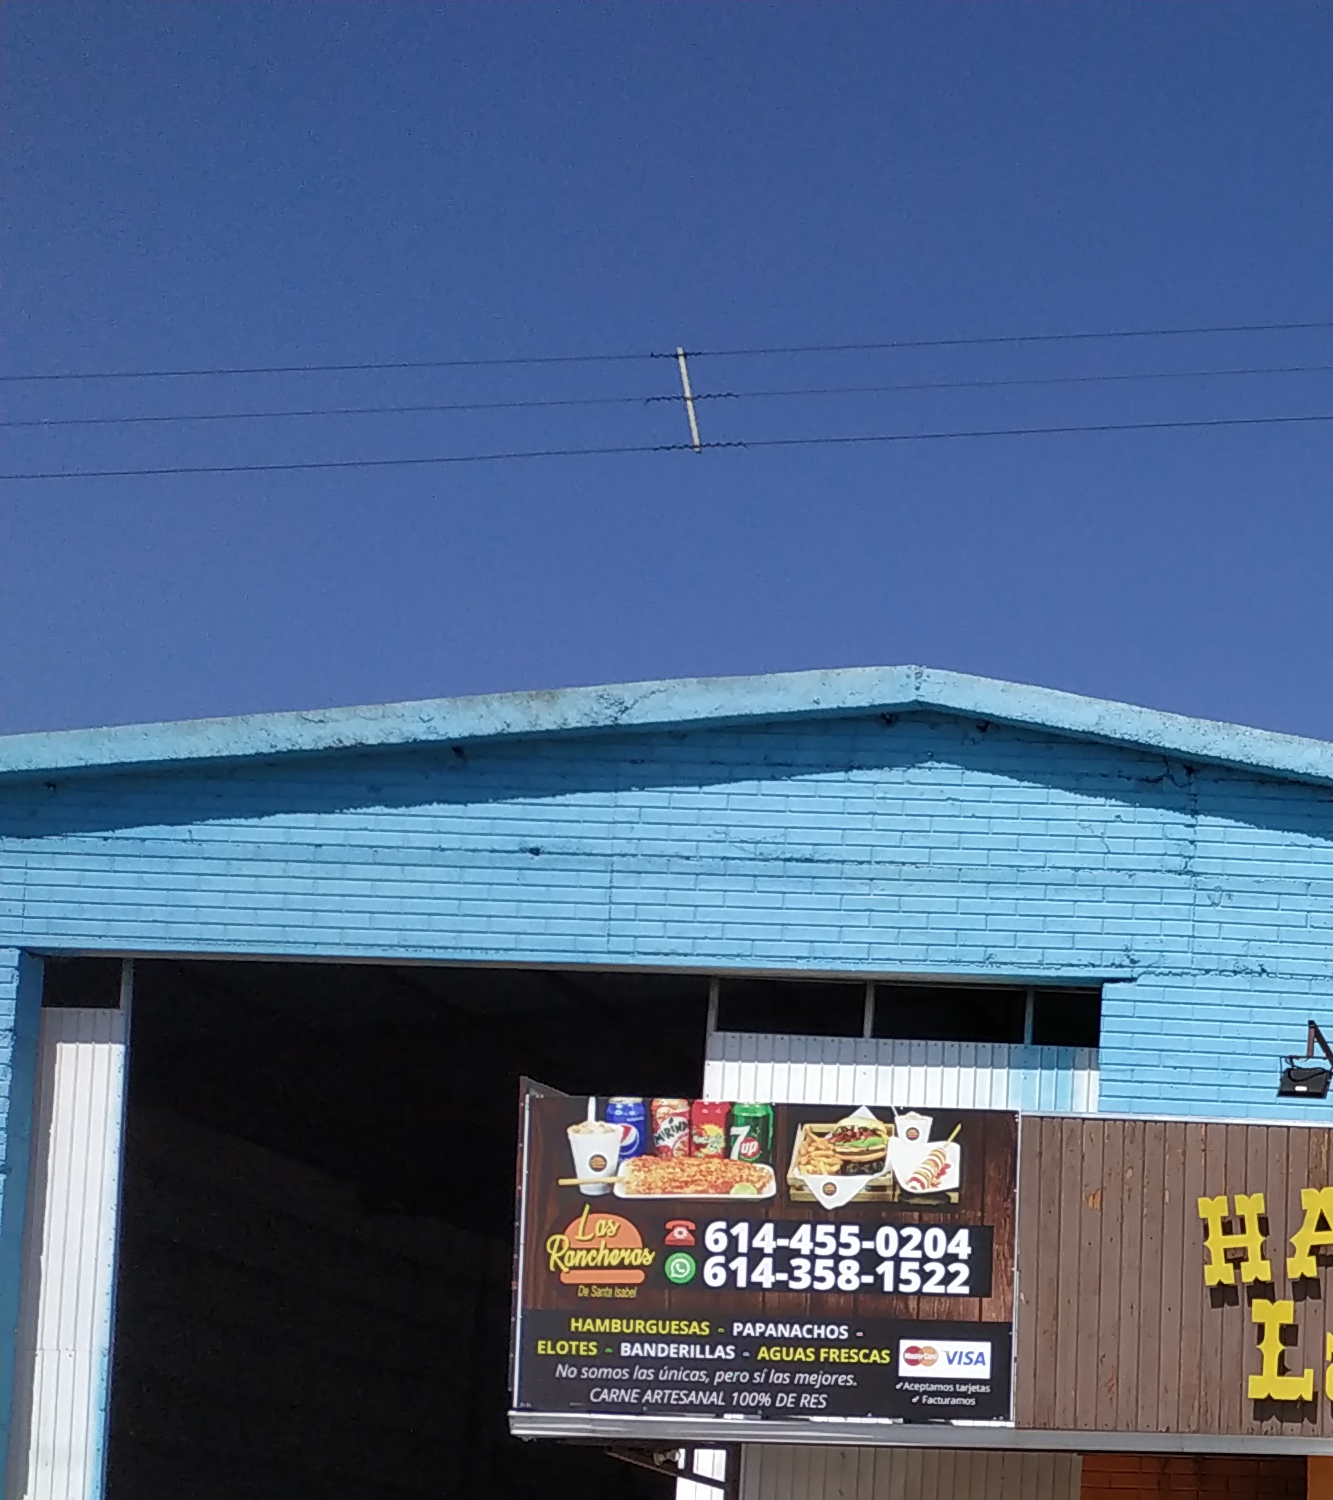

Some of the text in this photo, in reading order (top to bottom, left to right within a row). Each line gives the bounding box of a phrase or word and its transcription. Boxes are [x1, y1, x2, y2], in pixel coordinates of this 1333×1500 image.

[575, 1204, 620, 1241] Las
[704, 1221, 972, 1259] 614-455-0204
[546, 1234, 656, 1273] Rancheras
[703, 1255, 970, 1295] 614-358-1522
[578, 1286, 637, 1298] De Santa Isabel
[570, 1317, 849, 1340] HAMBURGUESAS PAPANACHOS
[537, 1340, 891, 1364] ELOTES BANDERILLAS AGUAS FRESCAS
[943, 1350, 987, 1366] VISA
[555, 1363, 858, 1389] No somos las únicas, pero sí las mejores.
[589, 1388, 828, 1409] CARNE ARTESANAL 100% DE RES
[903, 1381, 991, 1395] Aceptamos tarjetas
[922, 1395, 976, 1406] Facturamos
